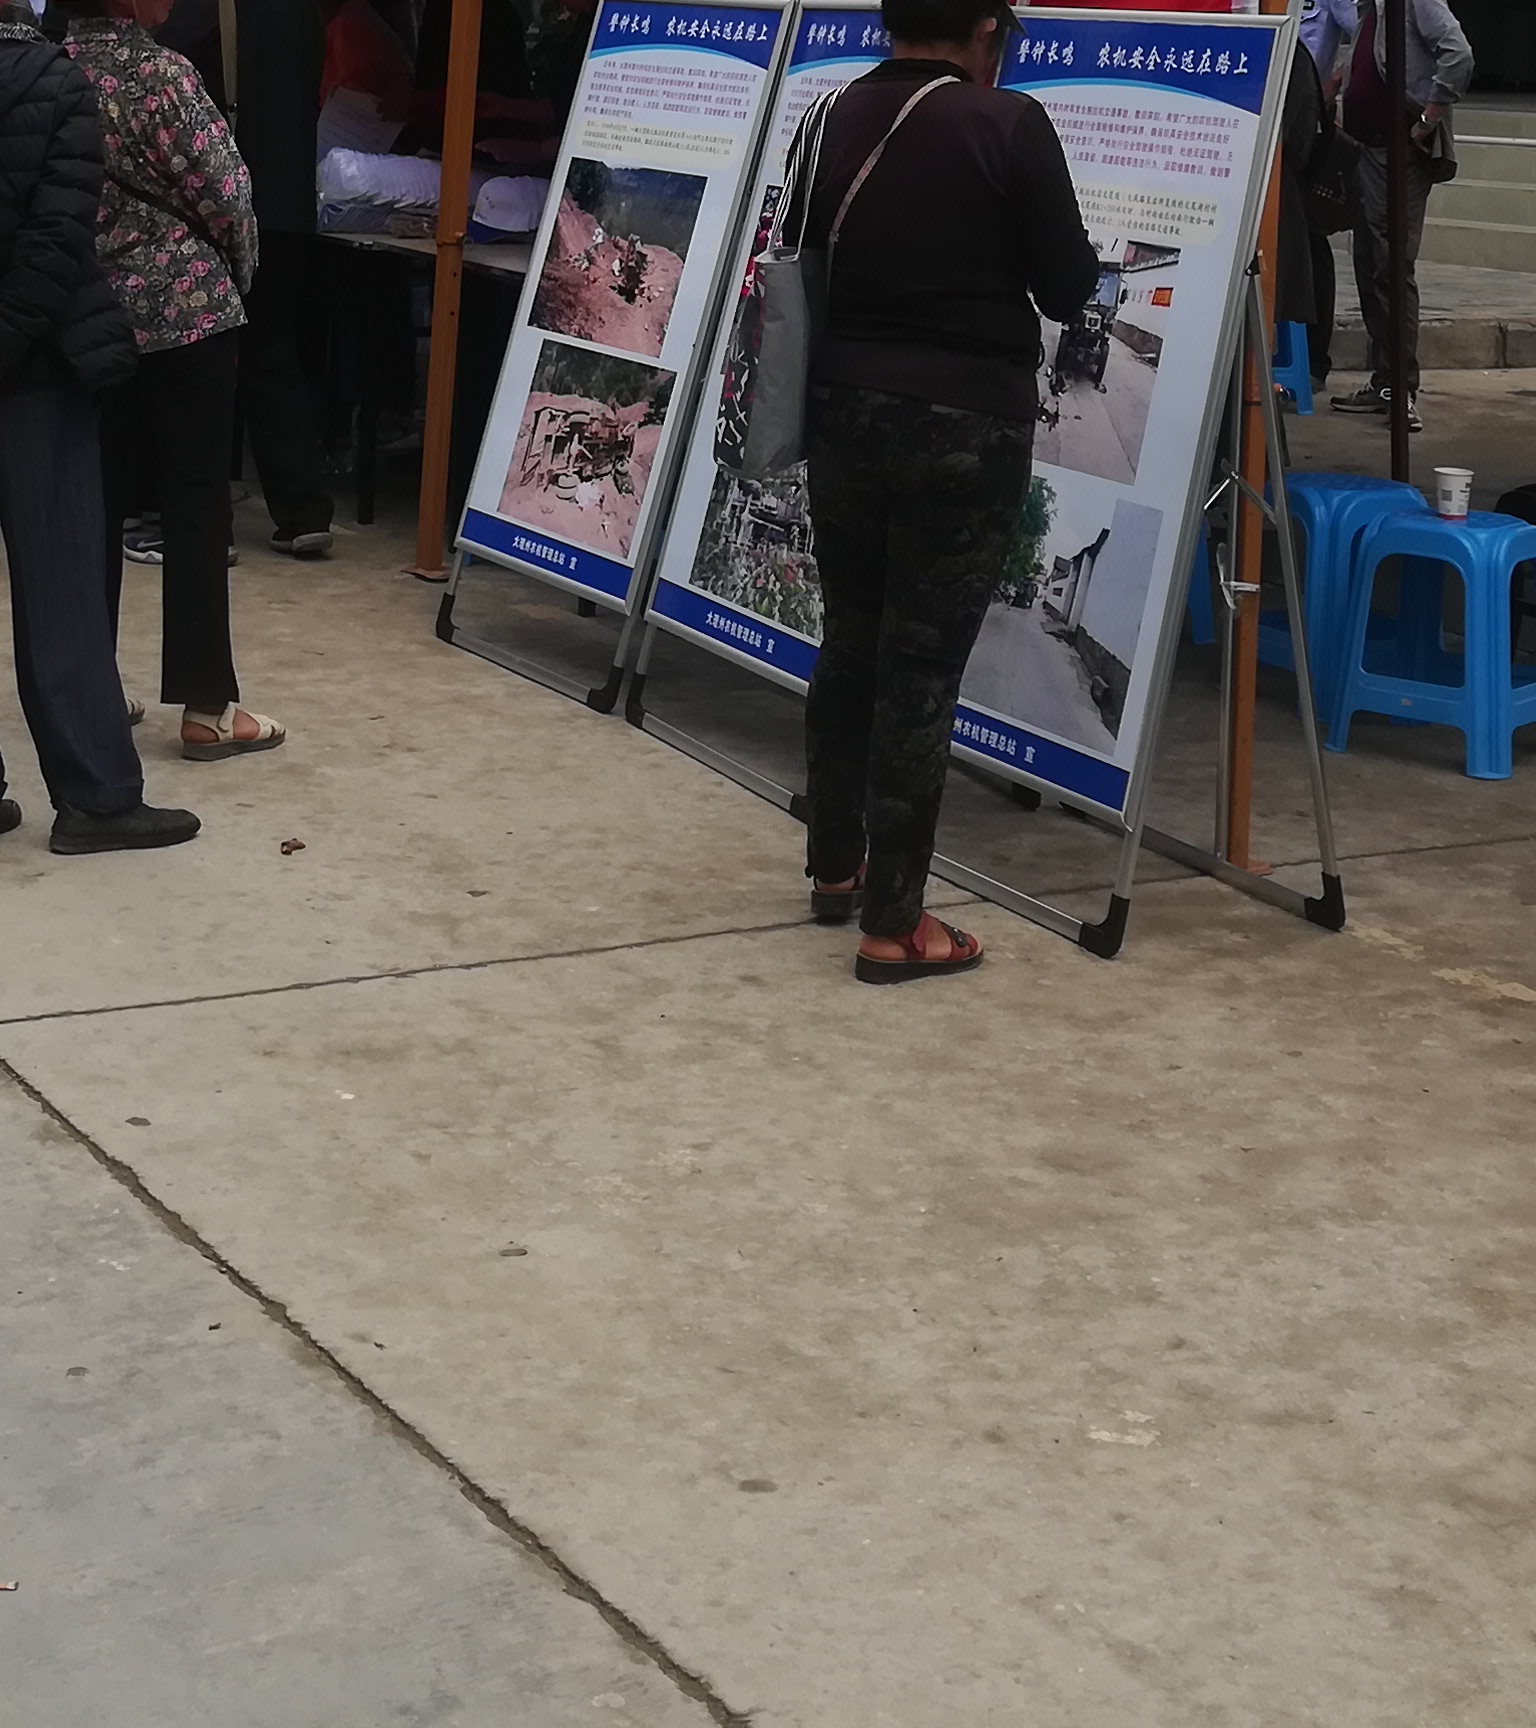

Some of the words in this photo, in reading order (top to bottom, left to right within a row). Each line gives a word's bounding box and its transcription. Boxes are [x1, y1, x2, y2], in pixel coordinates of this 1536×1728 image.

[1017, 38, 1075, 66] 警钟长鸣
[1096, 42, 1249, 76] 农机安全永远在路上
